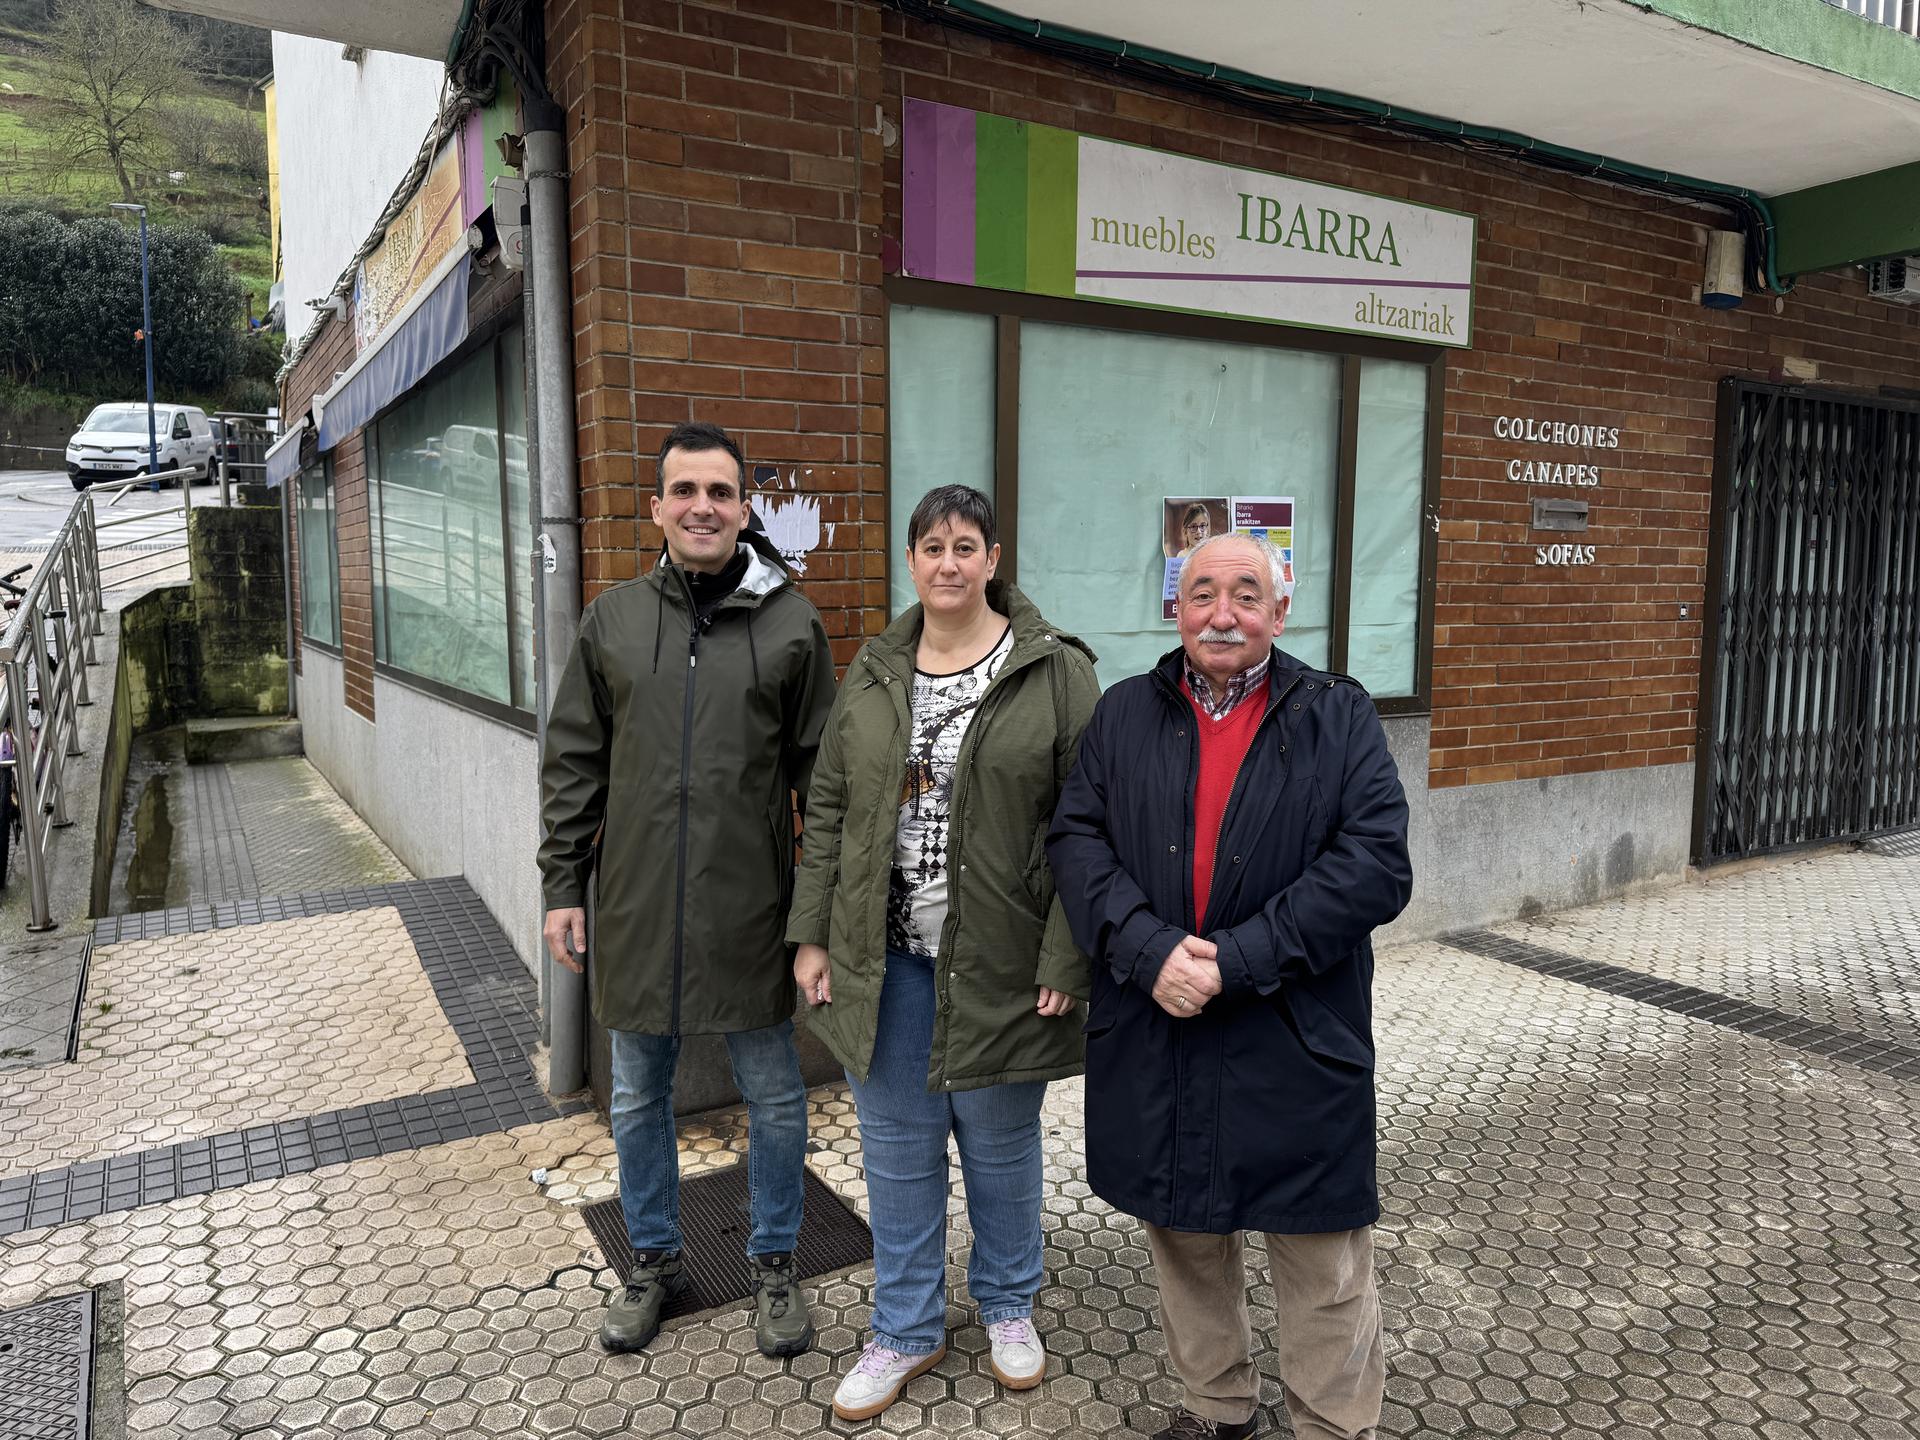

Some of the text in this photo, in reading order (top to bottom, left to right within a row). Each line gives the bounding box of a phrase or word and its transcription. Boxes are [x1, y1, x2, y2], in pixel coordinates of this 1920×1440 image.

[1090, 192, 1402, 267] muebles IBARRA
[1353, 292, 1456, 337] altzariak
[1494, 415, 1619, 449] COLCHONES
[1506, 459, 1599, 486] CANAPES
[1535, 543, 1596, 566] SOFAS
